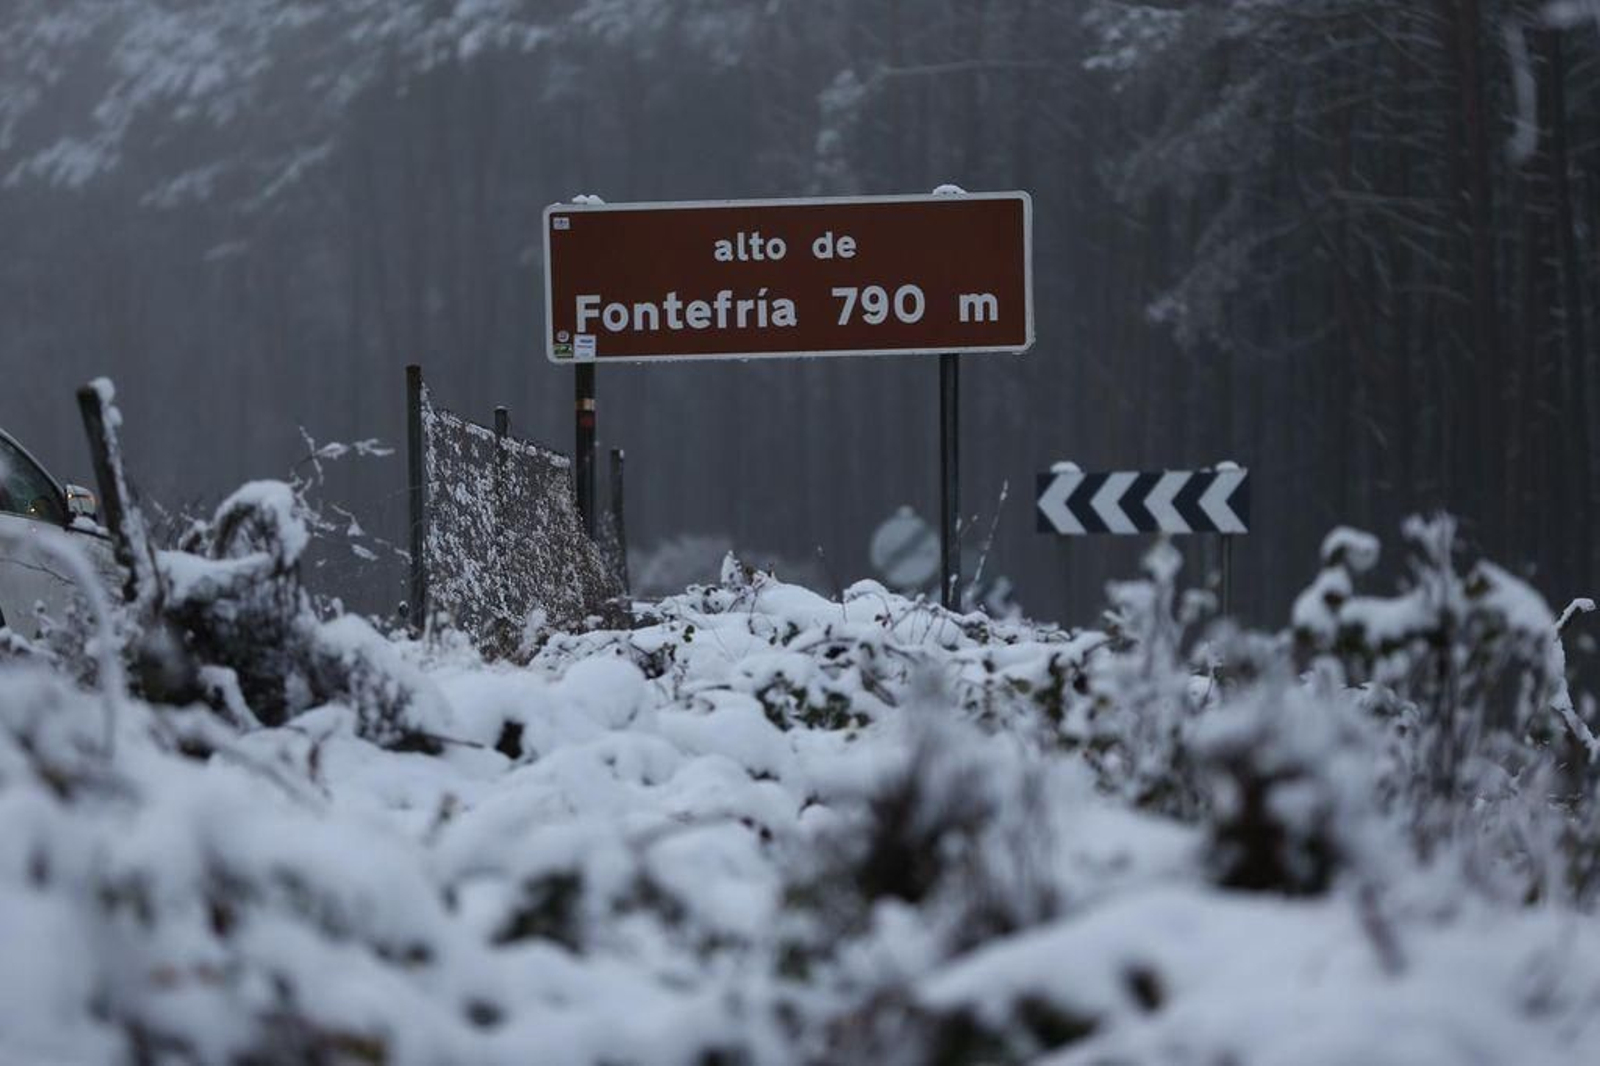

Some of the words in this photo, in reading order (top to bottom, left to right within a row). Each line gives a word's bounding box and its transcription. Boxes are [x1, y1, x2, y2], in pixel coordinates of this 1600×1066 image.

[713, 232, 787, 262] alto
[812, 231, 857, 259] de
[576, 287, 798, 333] Fontefría
[831, 284, 926, 326] 790
[959, 293, 998, 322] m
